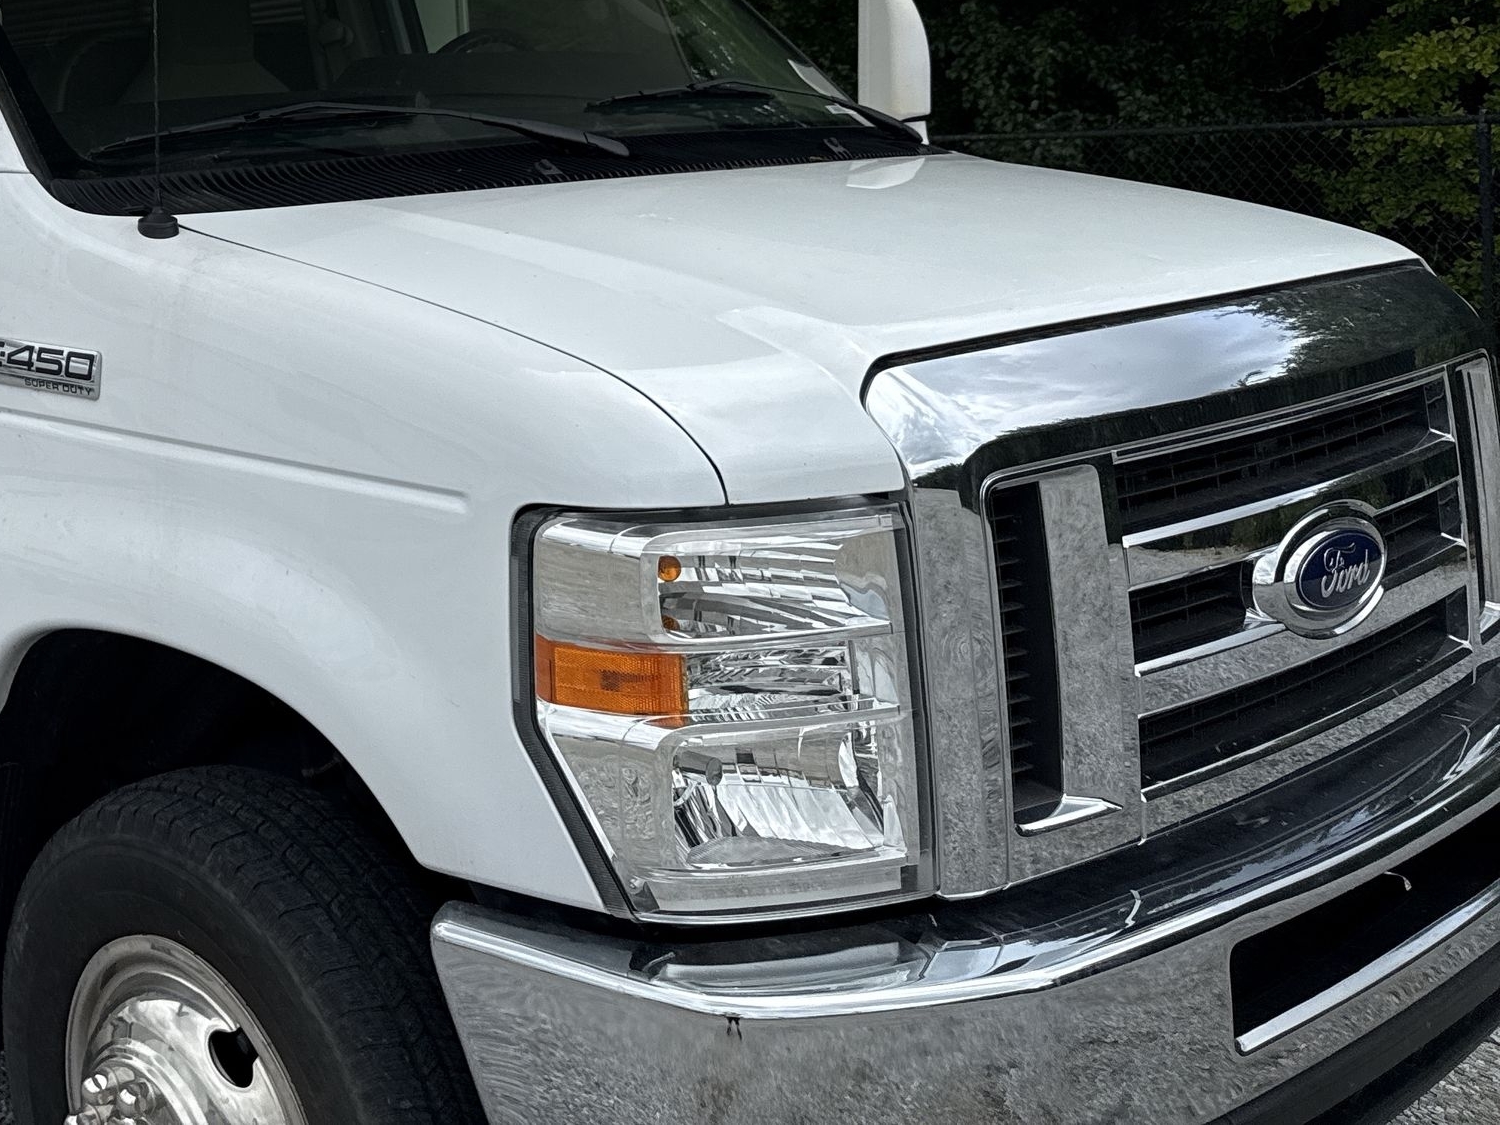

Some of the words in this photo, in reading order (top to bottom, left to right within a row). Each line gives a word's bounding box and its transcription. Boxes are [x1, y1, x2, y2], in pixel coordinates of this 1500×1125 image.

[24, 377, 60, 392] SUPER
[62, 382, 95, 396] DUTY
[1320, 542, 1371, 599] Ford
